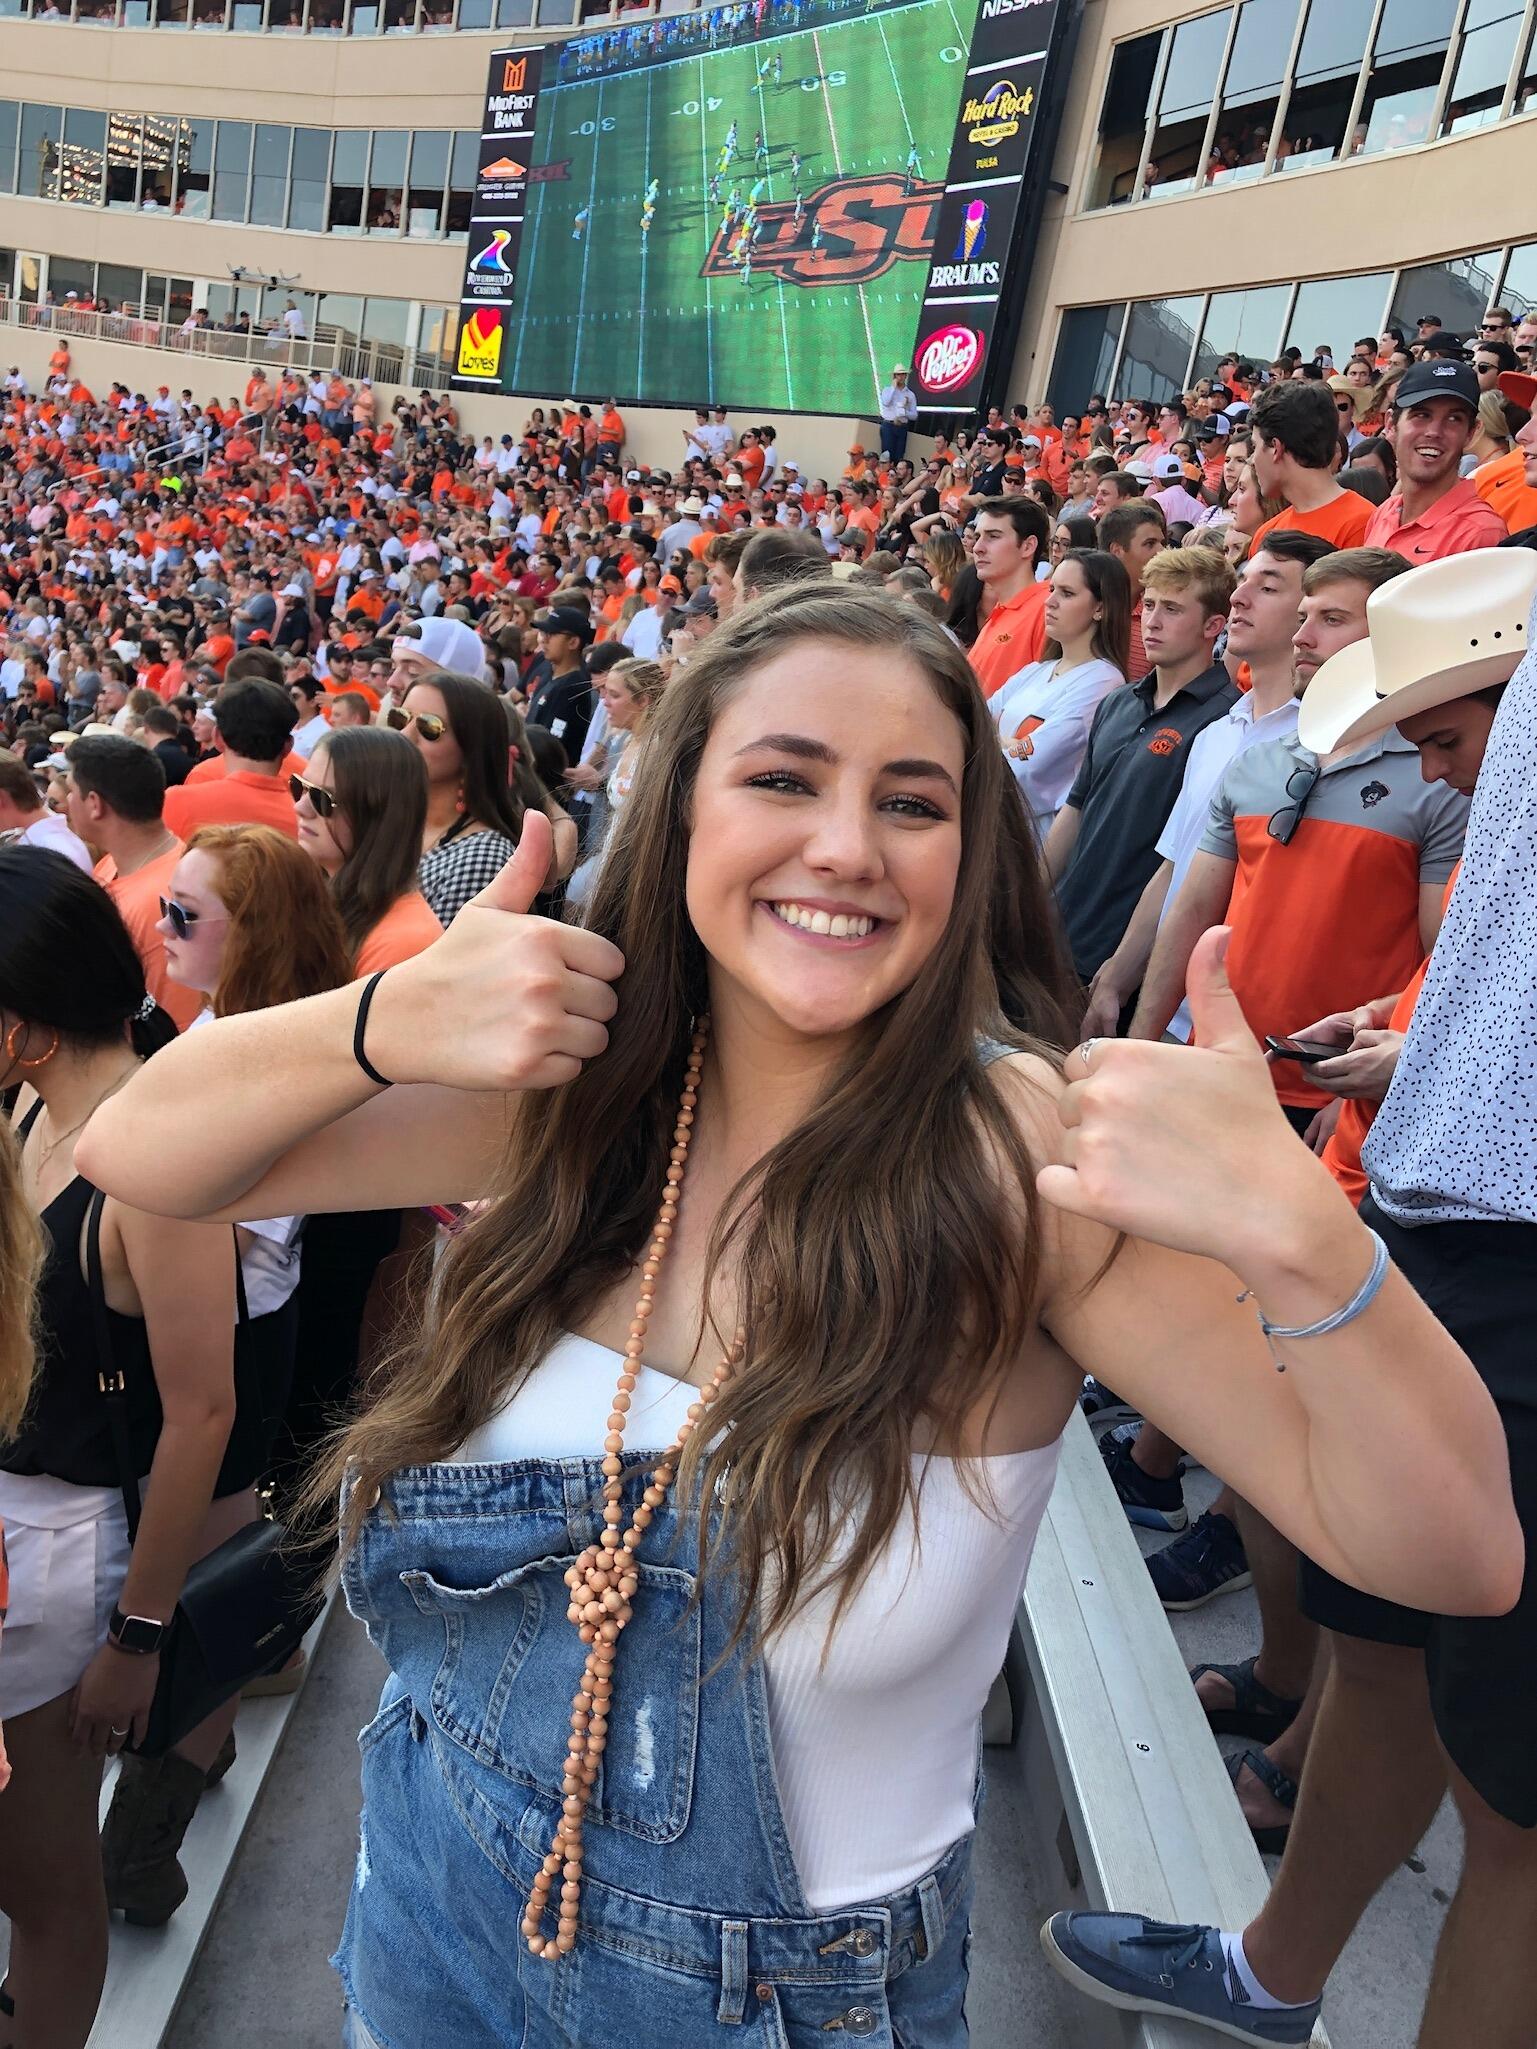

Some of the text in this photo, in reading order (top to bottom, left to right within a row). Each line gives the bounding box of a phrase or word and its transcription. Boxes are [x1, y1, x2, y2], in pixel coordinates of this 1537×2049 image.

[982, 0, 1052, 20] NISS
[962, 86, 1033, 123] Hard Rock
[929, 262, 999, 288] BRAUM'S
[942, 334, 963, 355] Dr
[921, 340, 974, 384] Pepper
